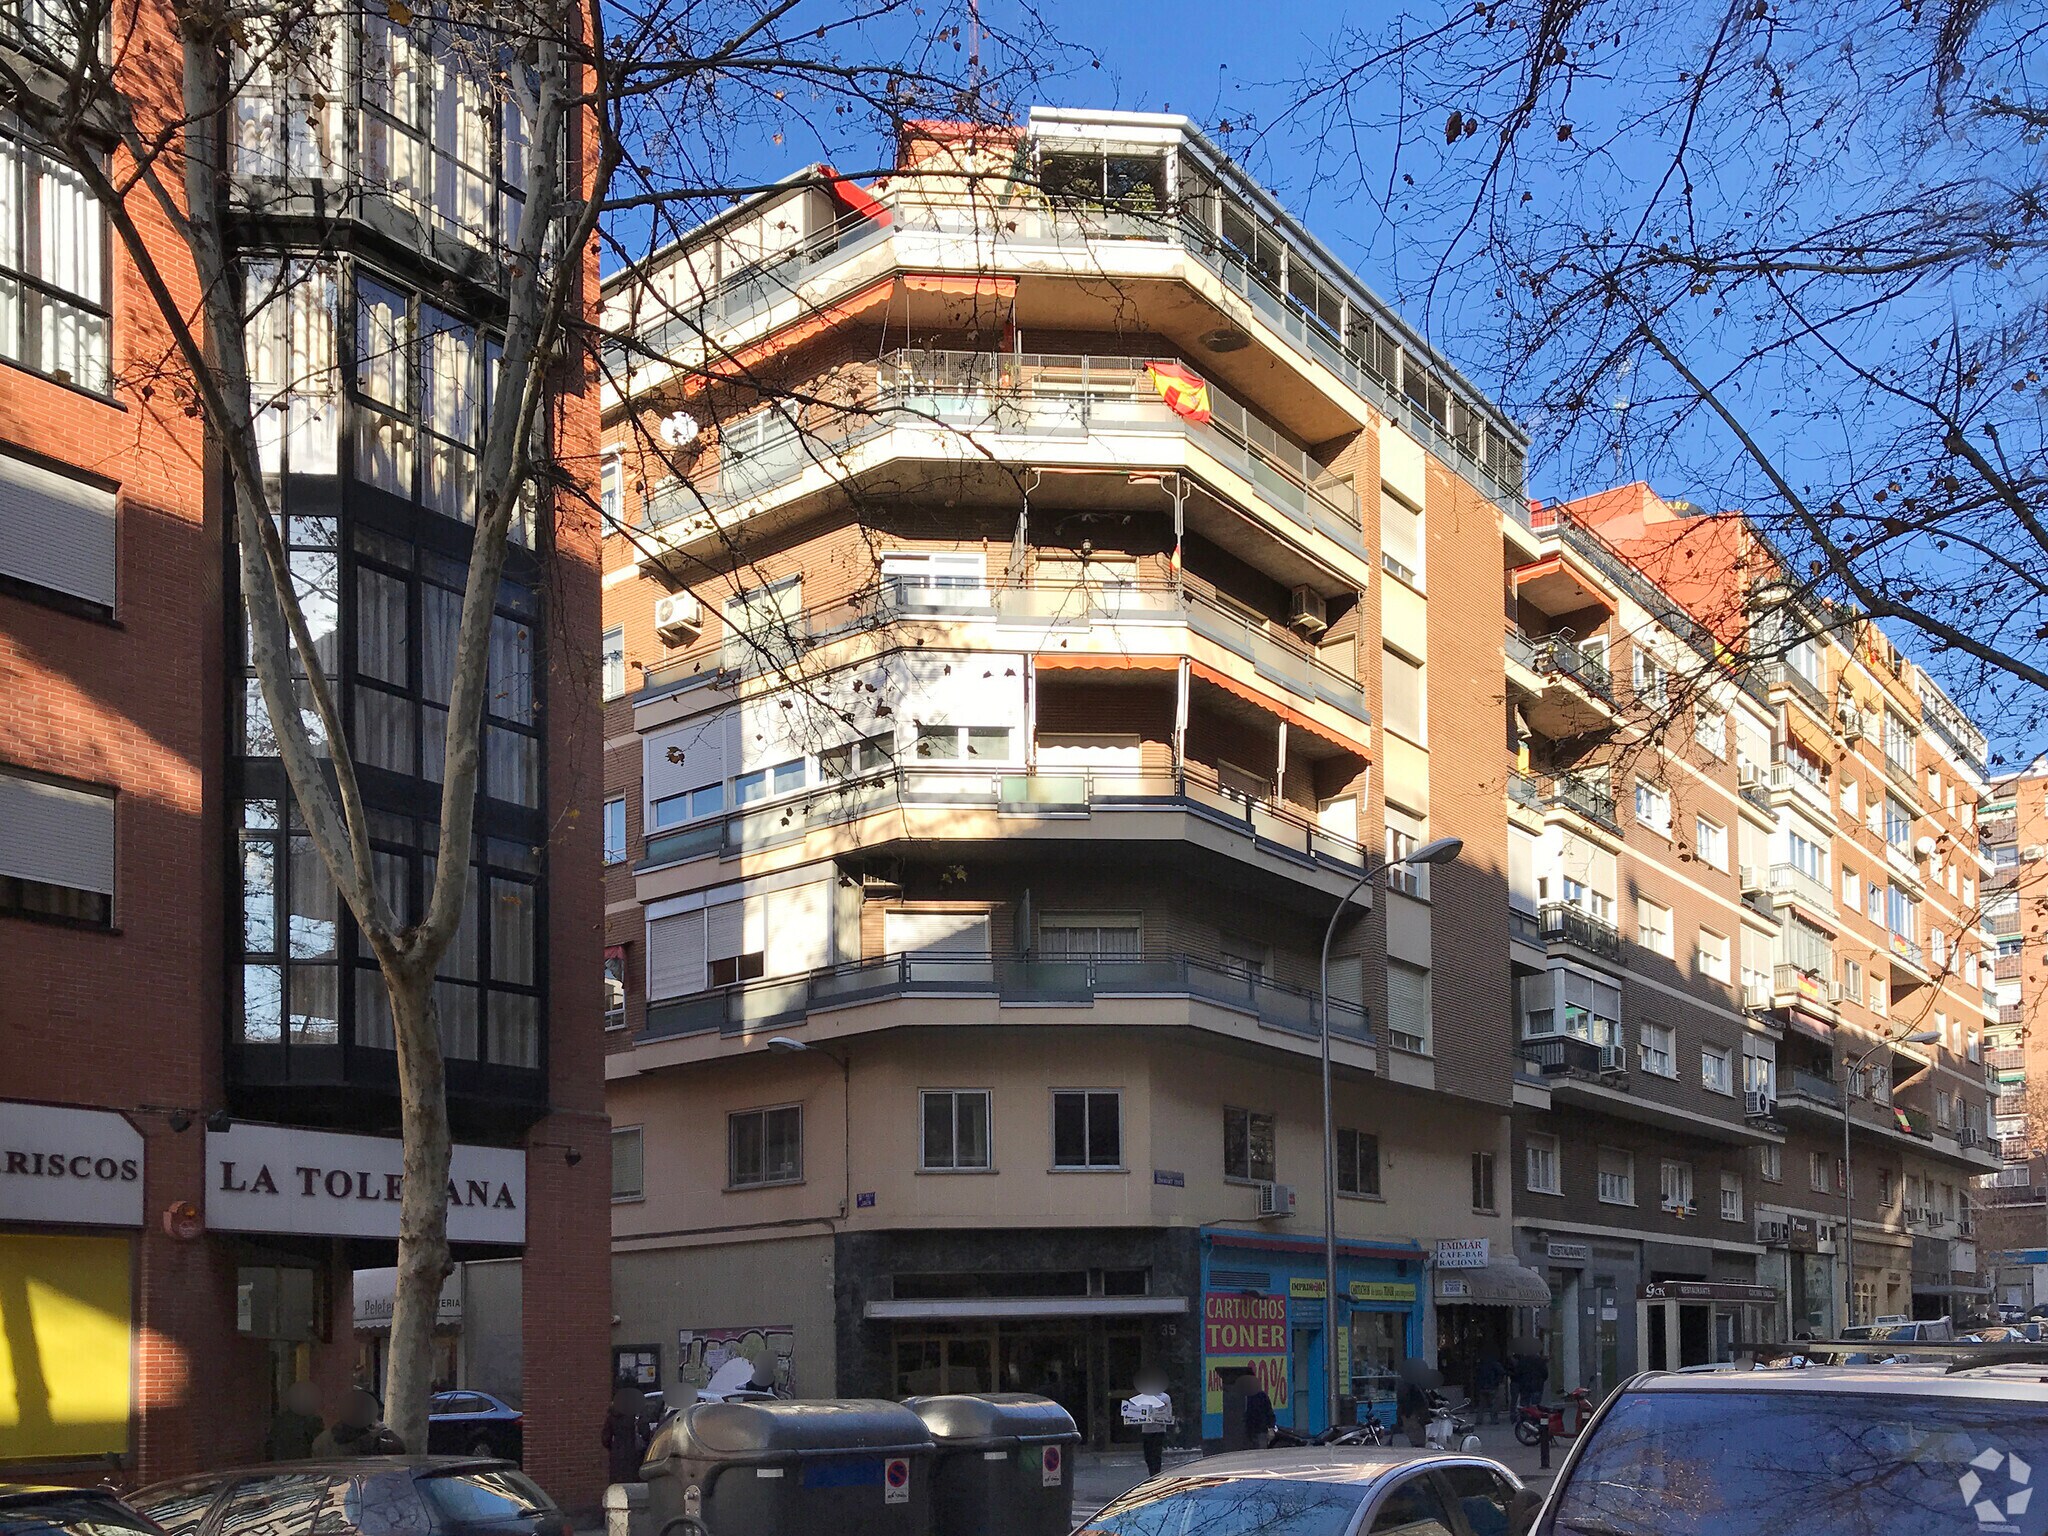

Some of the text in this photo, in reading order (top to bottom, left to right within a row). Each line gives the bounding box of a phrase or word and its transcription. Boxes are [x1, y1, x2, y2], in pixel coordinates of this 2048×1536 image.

[0, 1151, 138, 1181] RISCOS
[219, 1161, 516, 1209] LA TOLEANA
[1441, 1241, 1482, 1251] EMIMAR
[1206, 1298, 1285, 1320] CARTUCHOS
[1161, 1324, 1177, 1336] 35
[1207, 1324, 1285, 1348] TONER
